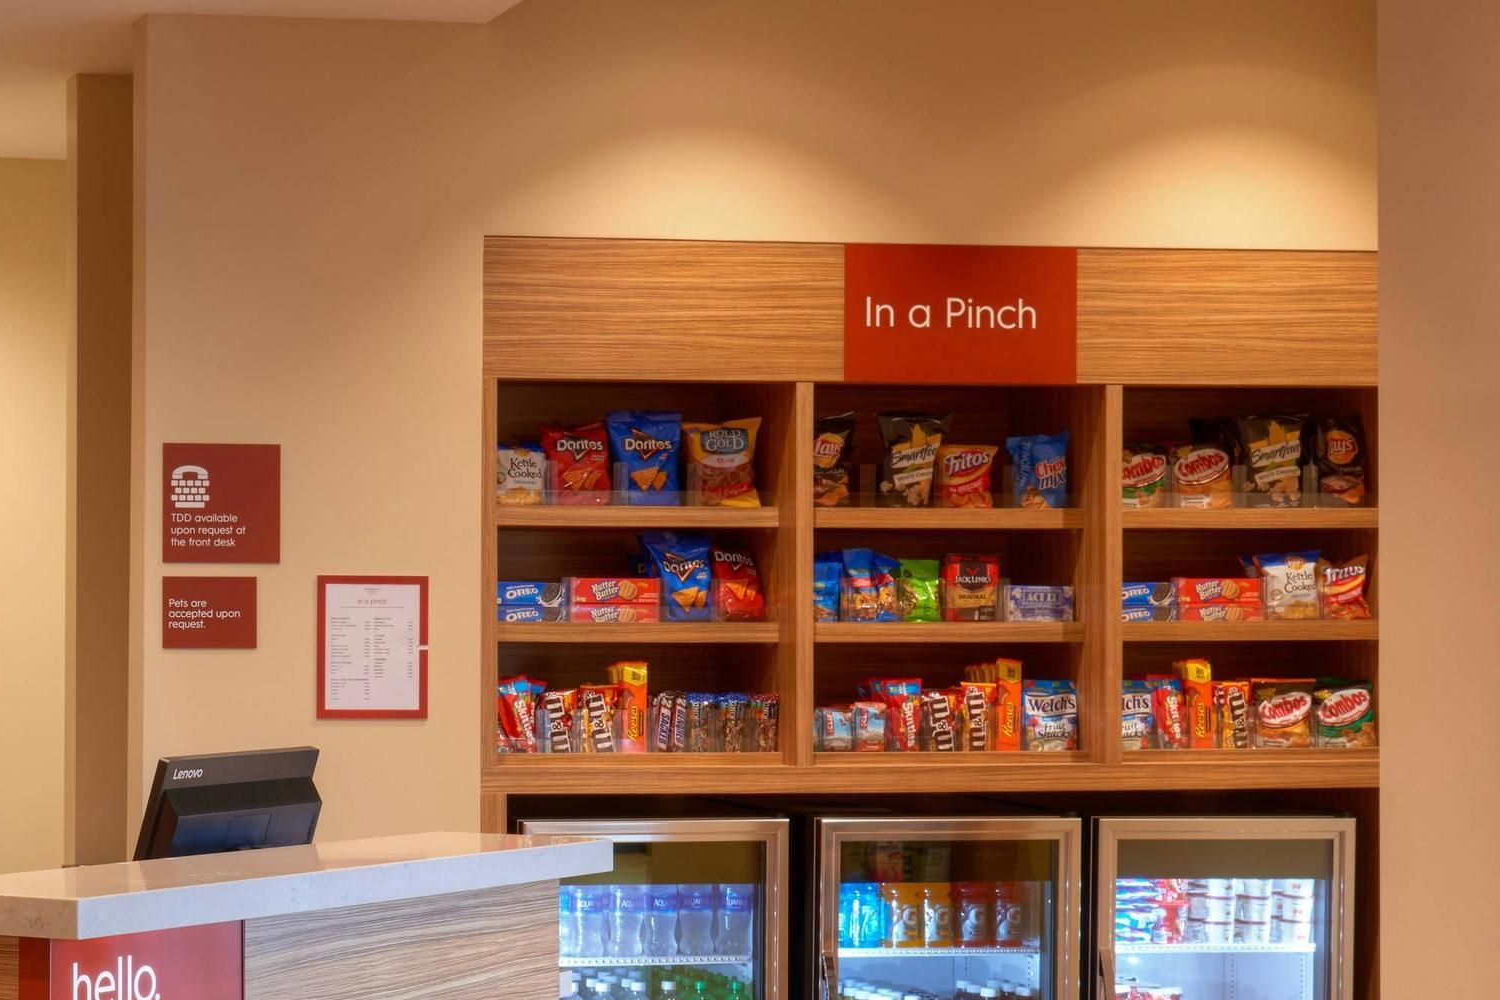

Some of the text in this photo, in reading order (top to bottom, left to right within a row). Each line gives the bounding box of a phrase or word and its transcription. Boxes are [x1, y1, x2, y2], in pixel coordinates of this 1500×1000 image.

[865, 296, 1038, 330] In a Pinch
[708, 429, 742, 439] ROLD
[556, 439, 604, 452] Doritos
[624, 438, 673, 451] Doritos
[704, 438, 745, 452] GOLD
[509, 457, 538, 470] Kettle
[944, 451, 989, 476] Fritos
[1124, 456, 1165, 480] ombos
[507, 468, 542, 479] Cooked
[170, 513, 238, 523] TDD available
[170, 525, 246, 536] upon request at
[170, 537, 236, 547] the front desk
[1285, 571, 1313, 583] Kettle
[591, 580, 617, 592] Nutter
[1195, 580, 1220, 594] Nutter
[505, 588, 539, 600] OREO
[595, 586, 620, 600] Butter
[1199, 586, 1223, 601] Butter
[168, 598, 207, 608] Pets are
[168, 608, 241, 620] accepted upon
[505, 610, 539, 622] OREO
[168, 619, 206, 630] request.
[1027, 696, 1076, 713] Welch's
[1122, 694, 1150, 712] lch's
[172, 768, 204, 780] Lenovo
